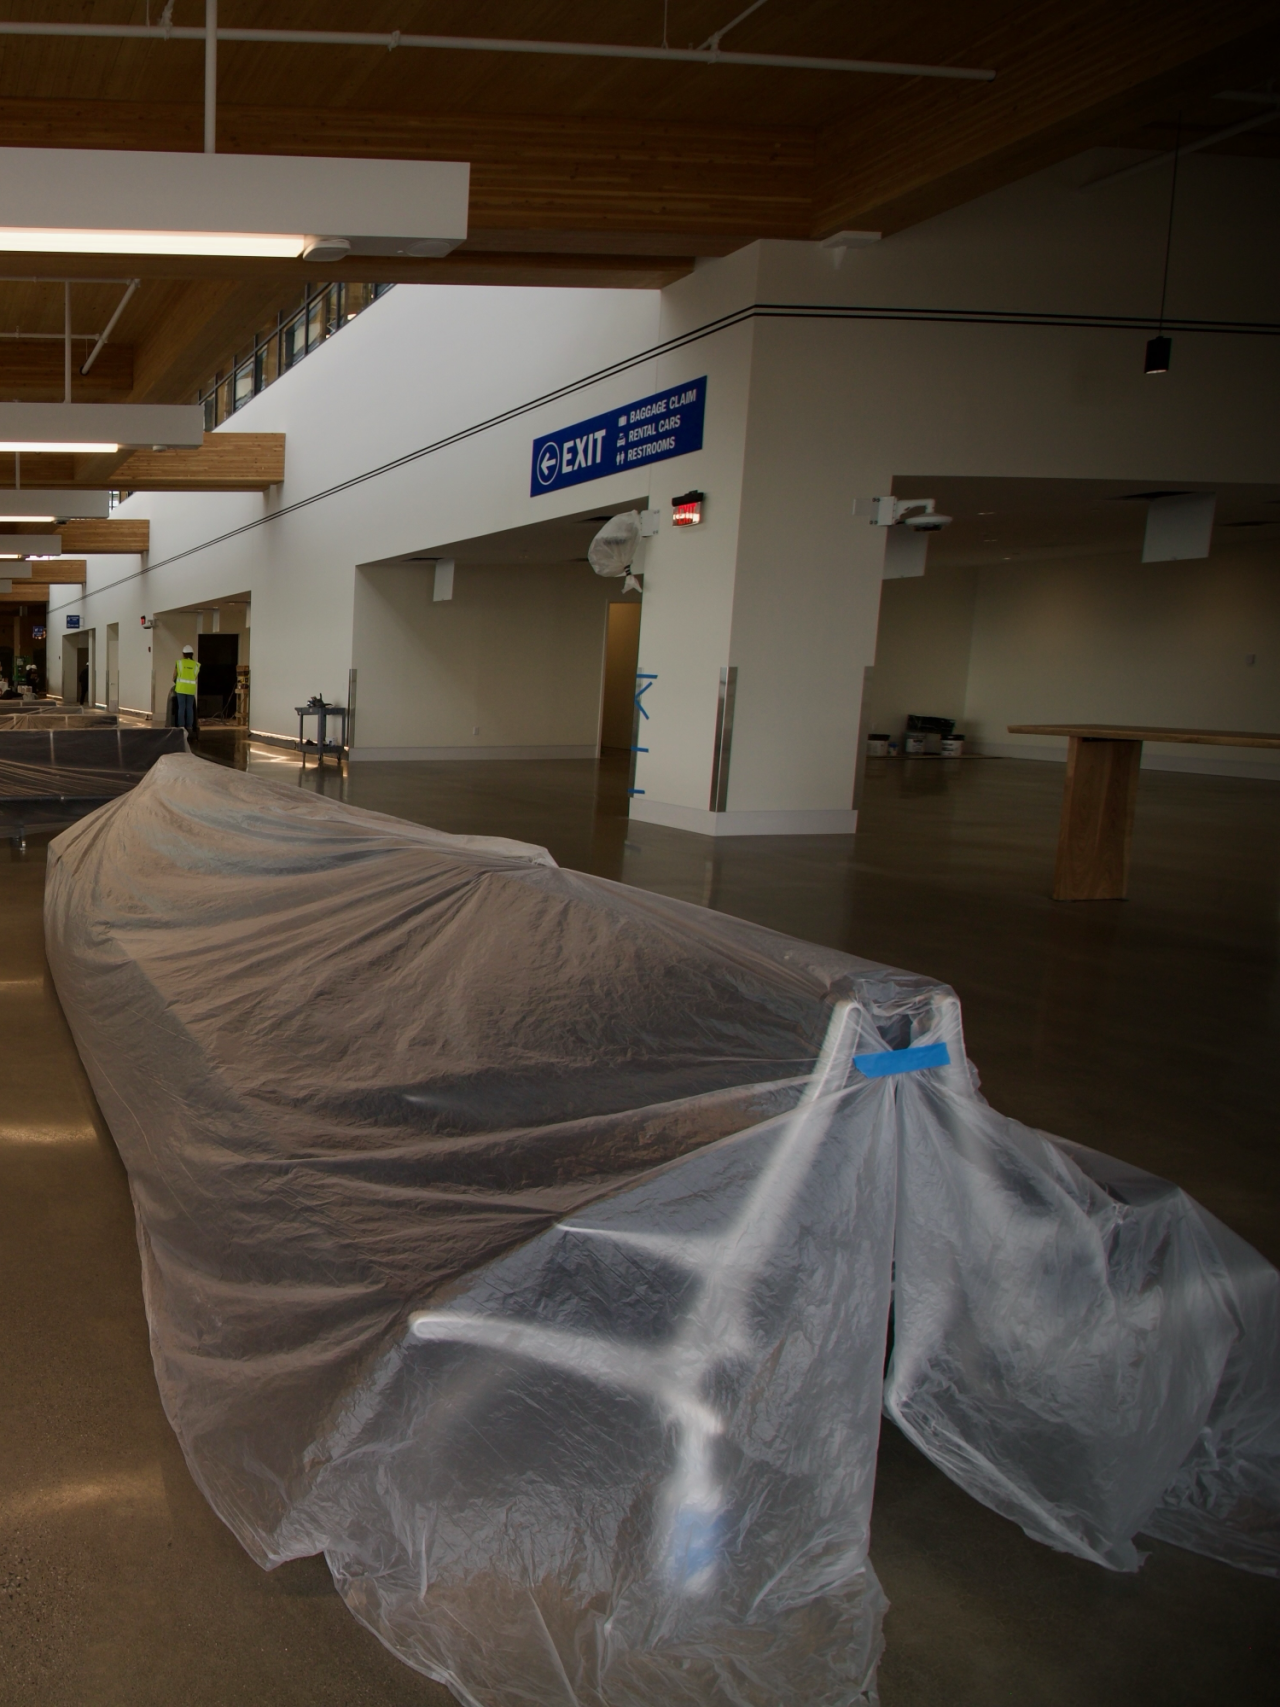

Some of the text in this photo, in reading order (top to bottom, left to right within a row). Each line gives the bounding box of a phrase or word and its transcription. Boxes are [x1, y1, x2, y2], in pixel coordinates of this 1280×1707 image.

[629, 388, 697, 424] BAGGAGE CLAIM
[628, 414, 681, 443] RENTAL CARS
[562, 429, 606, 474] EXIT
[627, 436, 676, 462] RESTROOMS
[677, 502, 697, 525] EXIT
